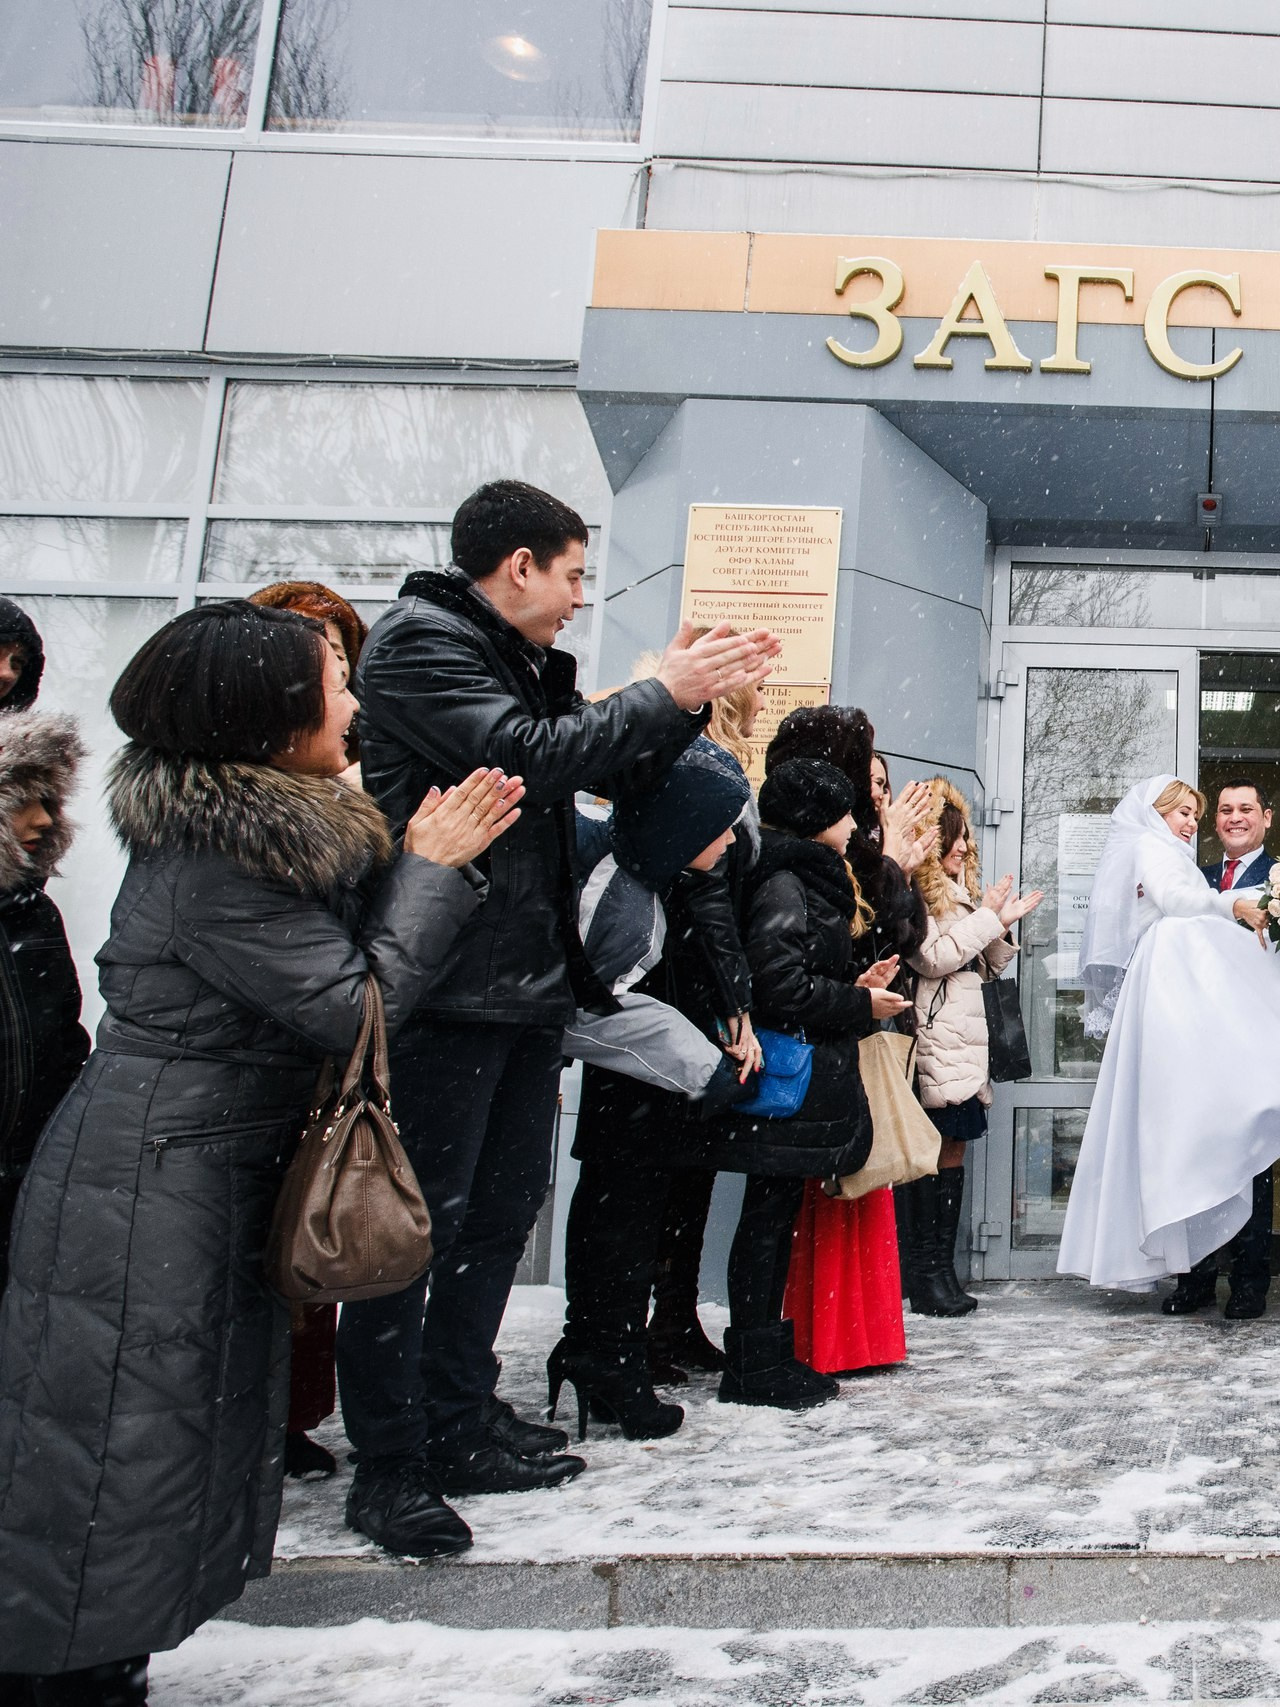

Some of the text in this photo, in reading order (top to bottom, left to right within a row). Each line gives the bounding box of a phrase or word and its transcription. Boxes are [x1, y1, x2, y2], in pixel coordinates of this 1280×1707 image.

[826, 255, 1243, 380] ЗАГС
[694, 534, 743, 542] ЮСТИЦИЯ
[756, 547, 810, 555] КОМИТЕТЫ
[712, 567, 744, 575] СОВЕТ
[693, 599, 823, 610] Государственный комитет
[691, 611, 824, 623] Республики Башкортостан
